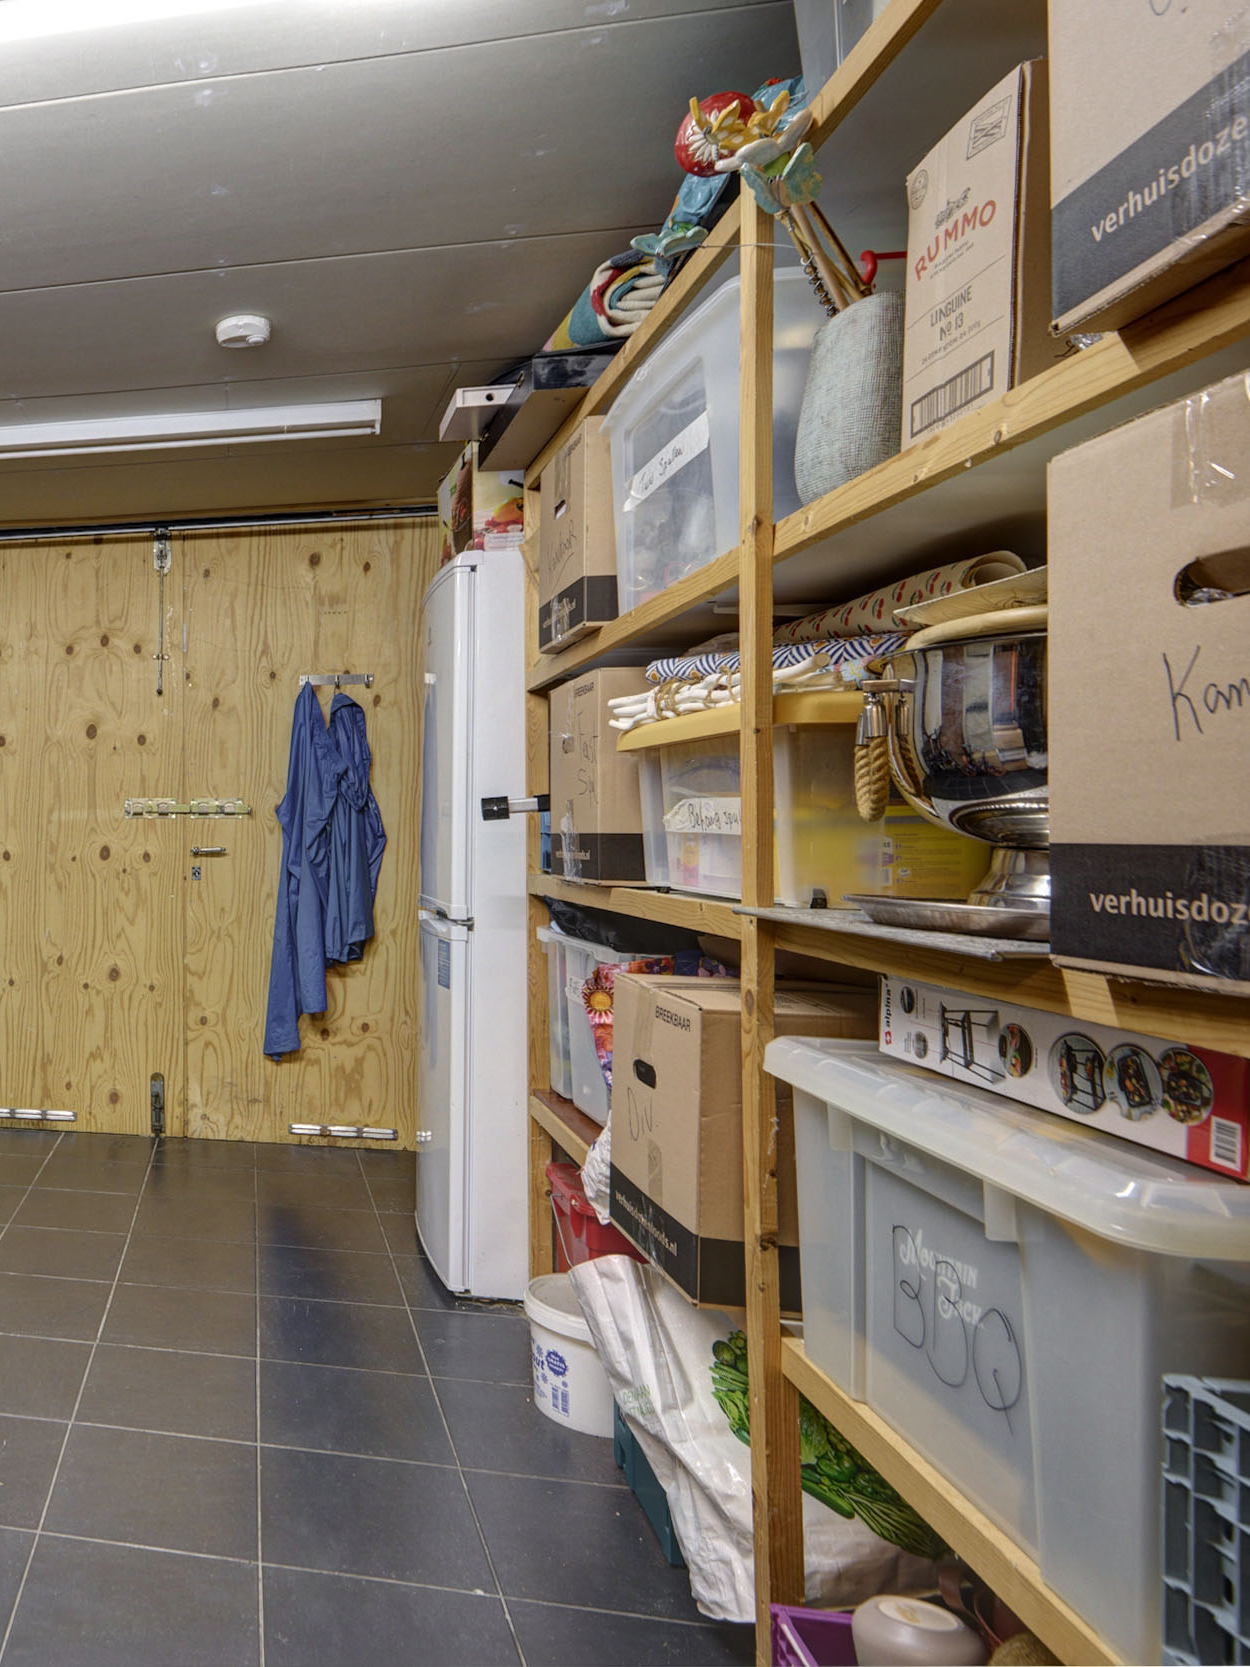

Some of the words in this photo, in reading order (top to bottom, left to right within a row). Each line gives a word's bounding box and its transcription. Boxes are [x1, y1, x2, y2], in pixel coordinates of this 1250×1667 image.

[915, 200, 996, 281] RUMMO
[930, 285, 973, 328] LINGUINE
[954, 312, 964, 331] 13
[1090, 888, 1250, 925] verhuisdoz
[654, 1004, 691, 1033] BREEKBAAR
